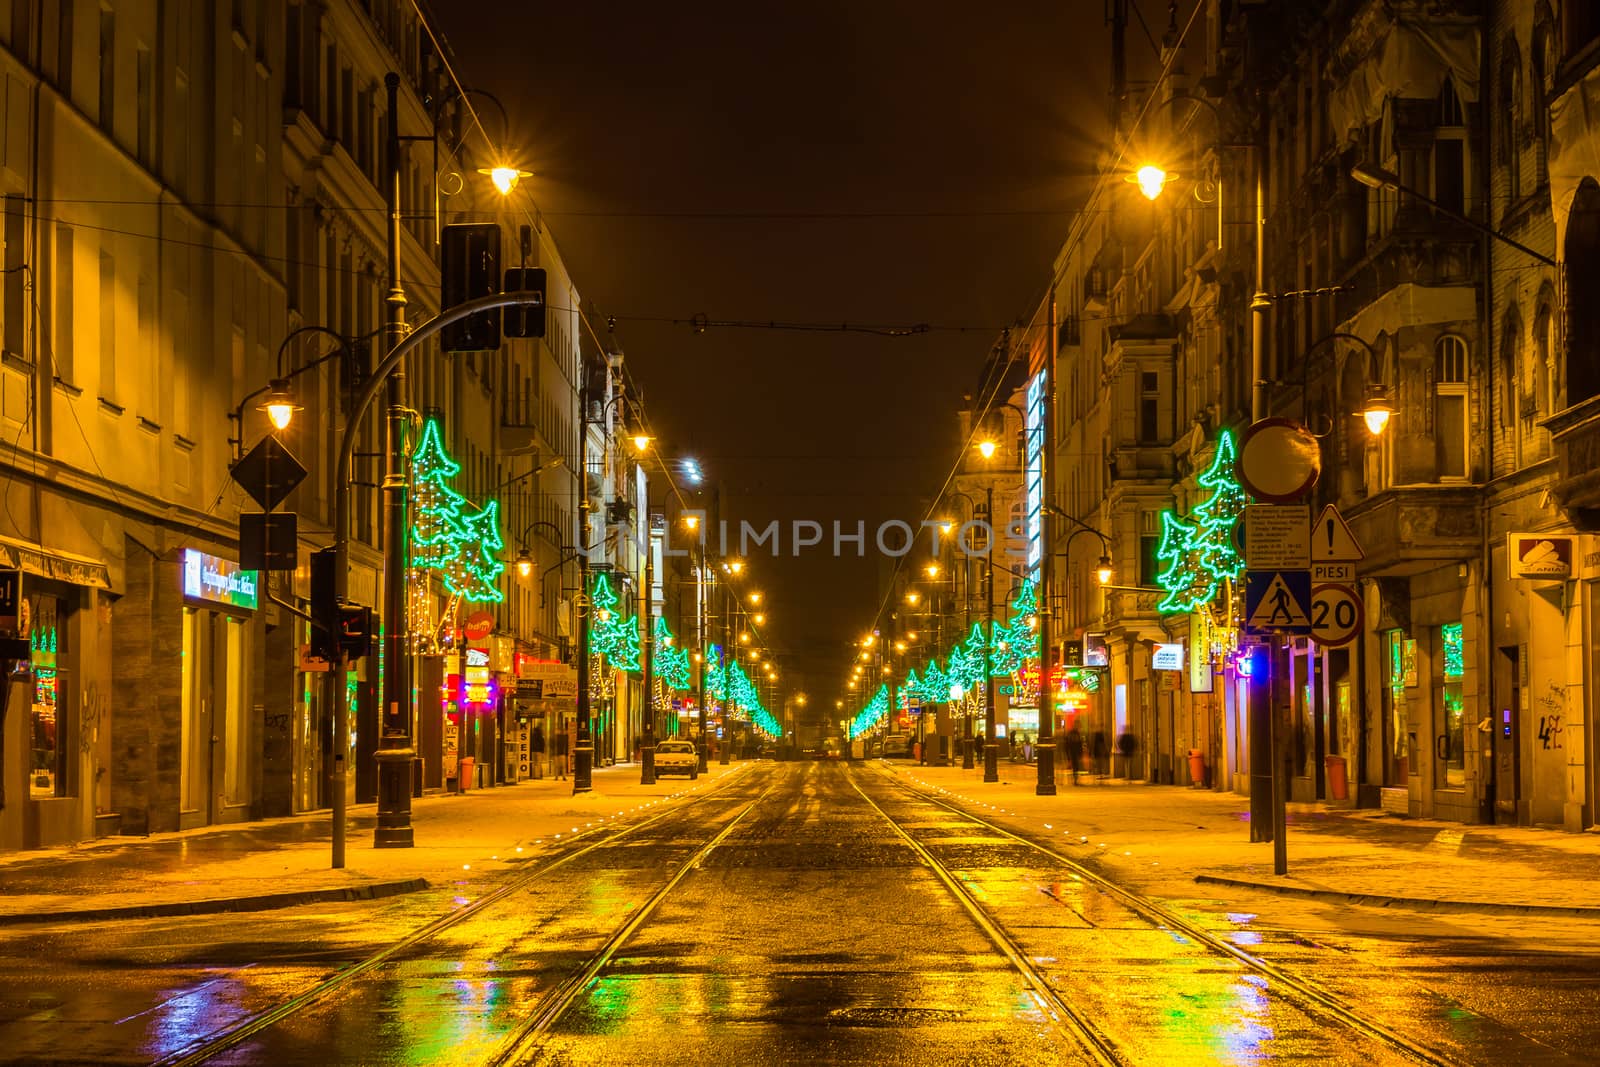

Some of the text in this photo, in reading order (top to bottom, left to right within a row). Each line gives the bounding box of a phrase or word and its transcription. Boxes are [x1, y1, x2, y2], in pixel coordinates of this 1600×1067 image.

[1315, 566, 1348, 578] PIESI
[1312, 600, 1356, 629] 20
[520, 722, 528, 772] KSERO
